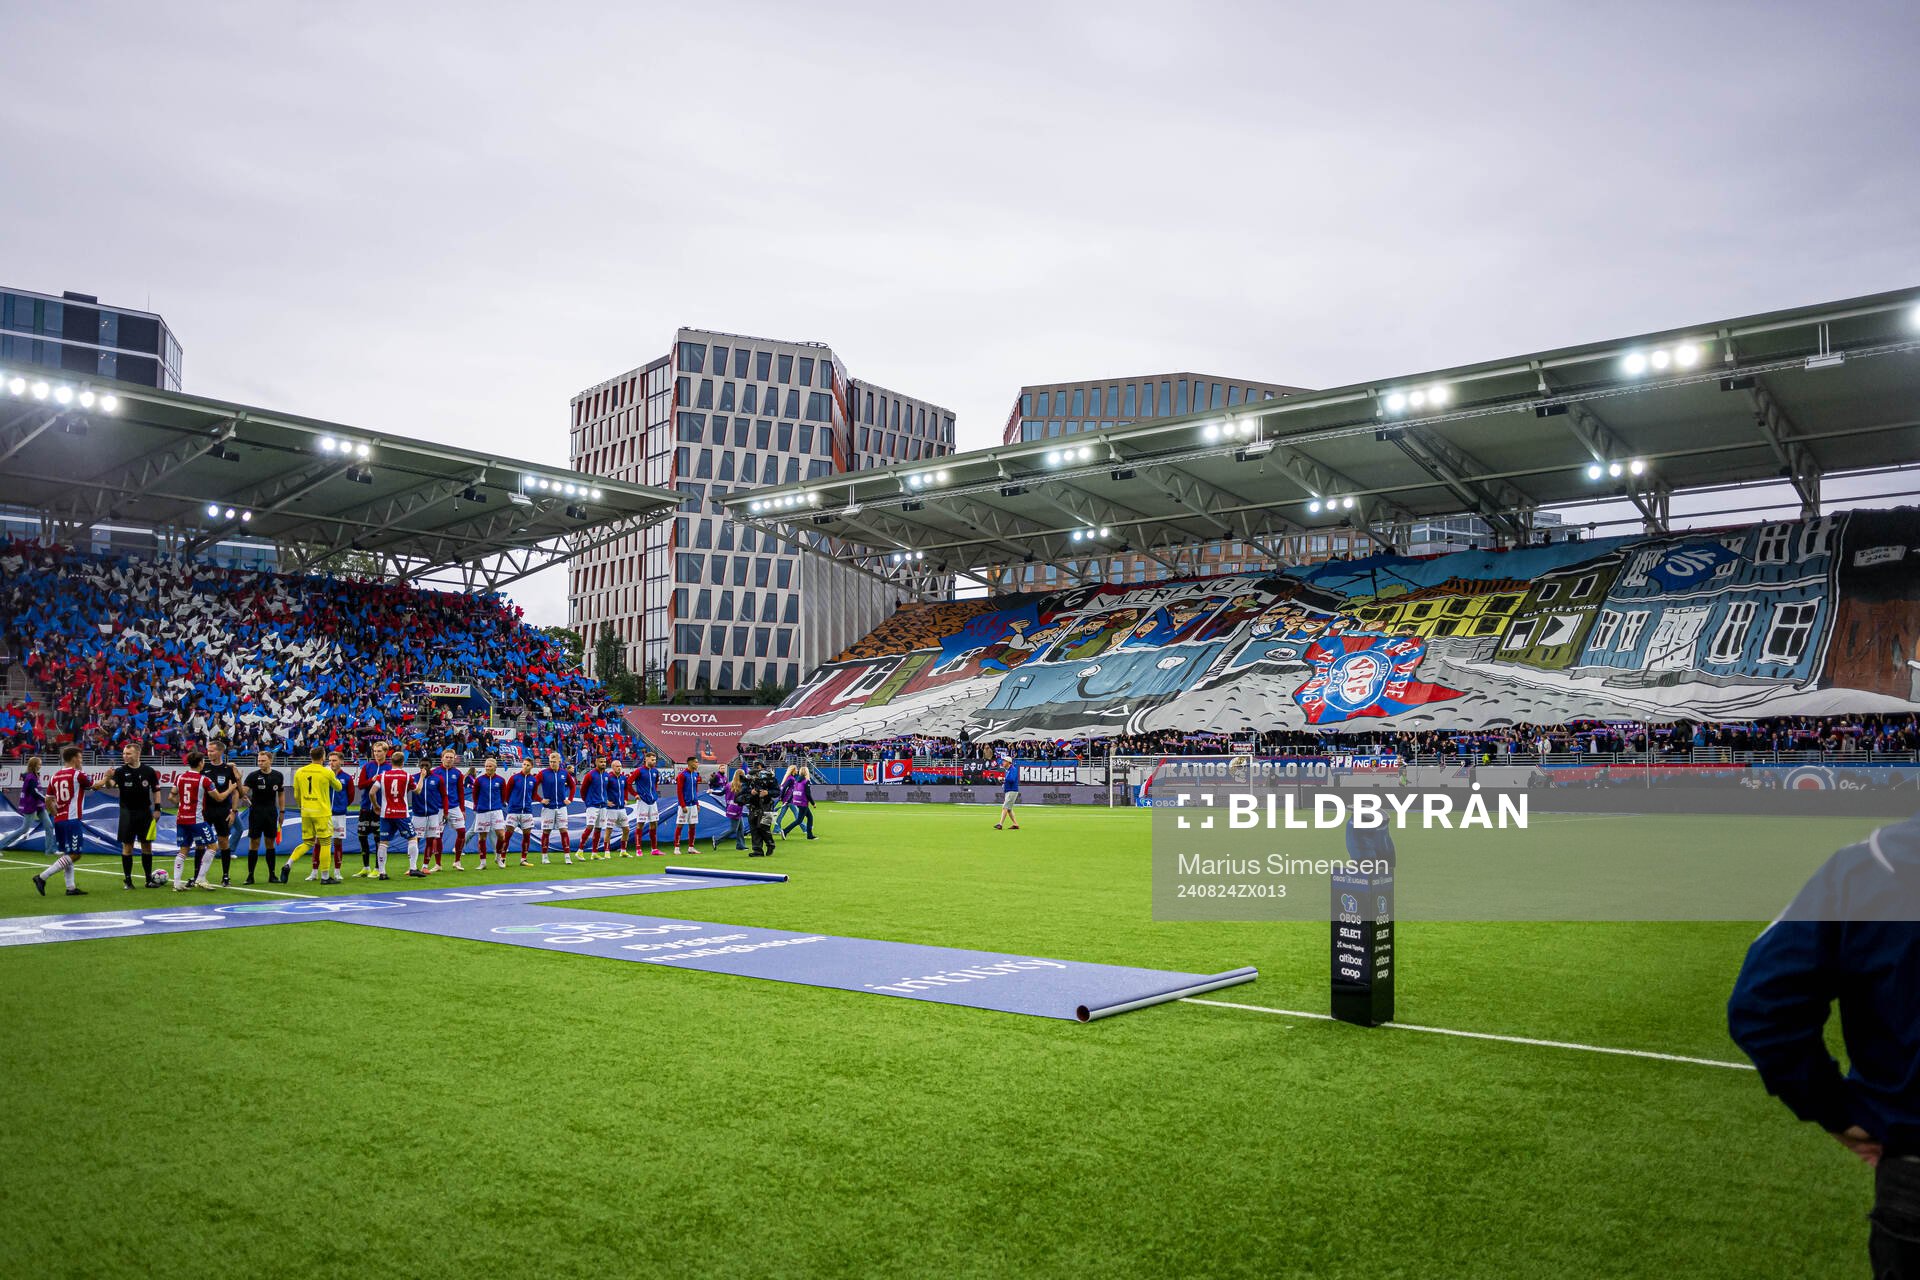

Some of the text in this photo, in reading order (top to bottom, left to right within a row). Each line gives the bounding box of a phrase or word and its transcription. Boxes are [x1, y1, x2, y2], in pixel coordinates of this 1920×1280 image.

[425, 684, 460, 695] sloTaxi
[661, 713, 718, 723] TOYOTA
[661, 729, 700, 737] MATERIAL
[1019, 766, 1076, 783] KOKOS
[53, 780, 71, 802] 16
[183, 783, 192, 804] 5
[306, 775, 313, 795] 1
[390, 779, 399, 797] 4
[396, 877, 710, 904] LIGAEN
[1339, 913, 1361, 925] OBOS
[543, 924, 704, 944] OBOS
[1340, 928, 1361, 939] SELECT
[1339, 953, 1362, 966] altibox
[863, 959, 1067, 993] intility
[1341, 967, 1360, 979] coop
